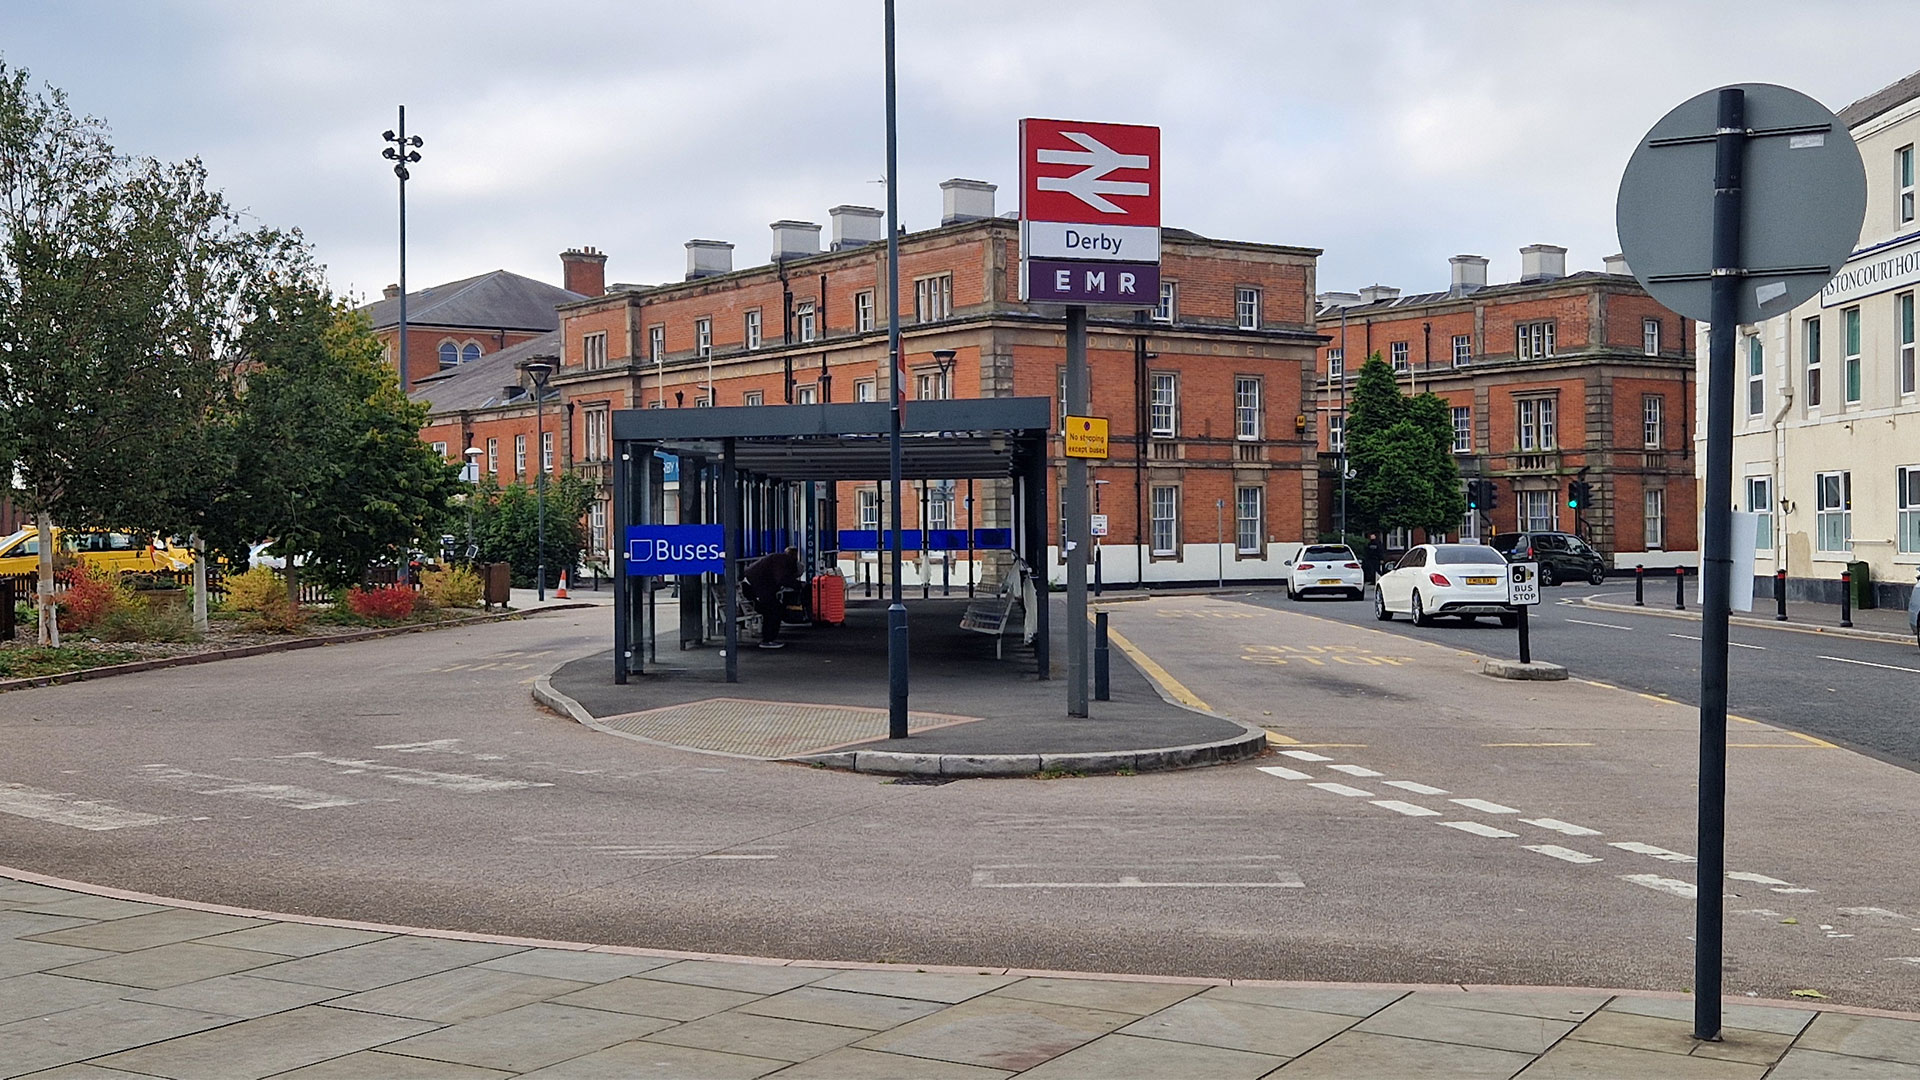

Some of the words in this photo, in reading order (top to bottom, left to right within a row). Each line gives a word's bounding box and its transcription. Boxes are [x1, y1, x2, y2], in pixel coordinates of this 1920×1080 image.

[1066, 230, 1122, 254] Derby
[1080, 435, 1105, 443] stopping
[1068, 446, 1088, 454] except
[656, 539, 720, 560] Buses
[1513, 593, 1536, 601] STOP
